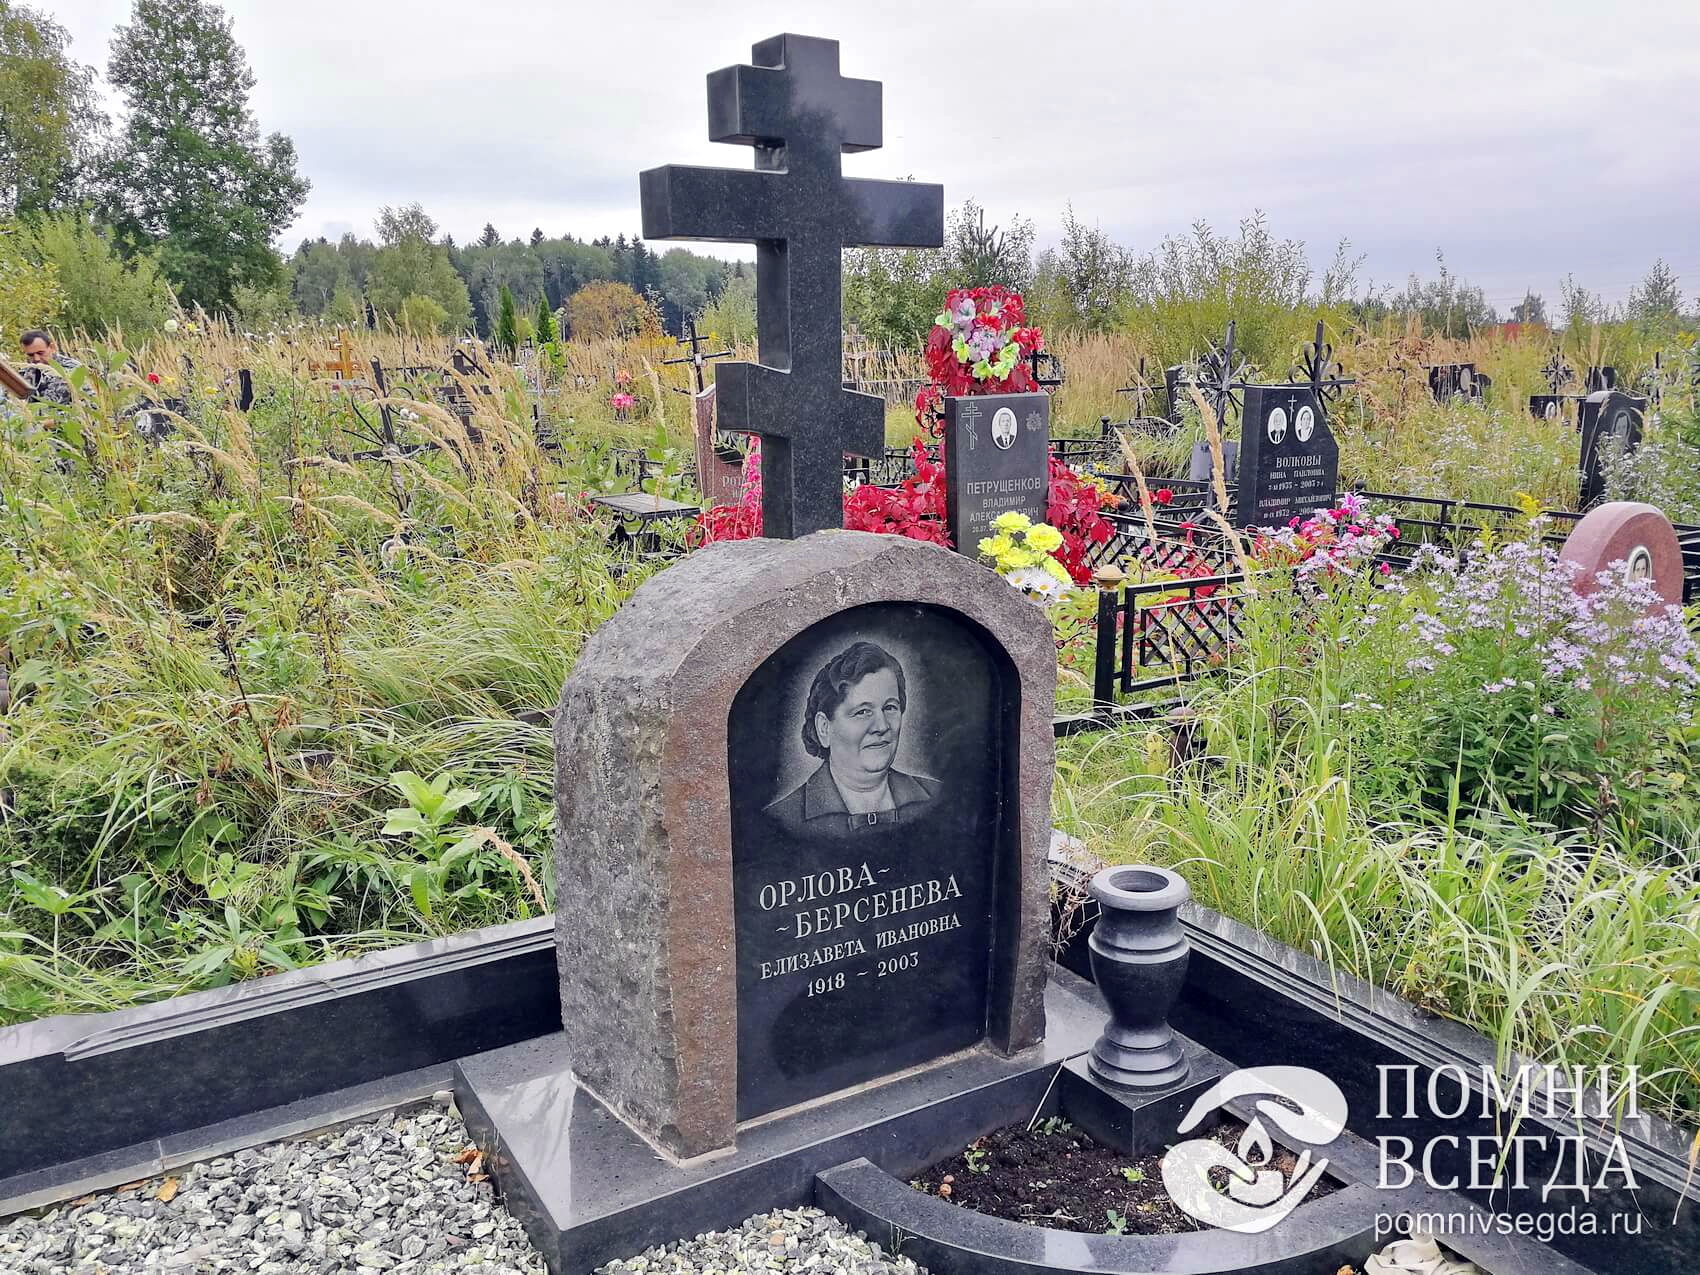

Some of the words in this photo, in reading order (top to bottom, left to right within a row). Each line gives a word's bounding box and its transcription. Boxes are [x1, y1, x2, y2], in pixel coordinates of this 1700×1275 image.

[1276, 455, 1321, 468] ВОЛКОВЫ
[967, 477, 1041, 495] ПЕТРУЩЕНКОВ
[982, 495, 1026, 509] ВЛАДИМИР
[759, 938, 867, 980] ЕЛИЗАВЕТА
[875, 912, 963, 950] ИВАНОВНА
[807, 972, 846, 998] 1918
[877, 951, 919, 978] 2003
